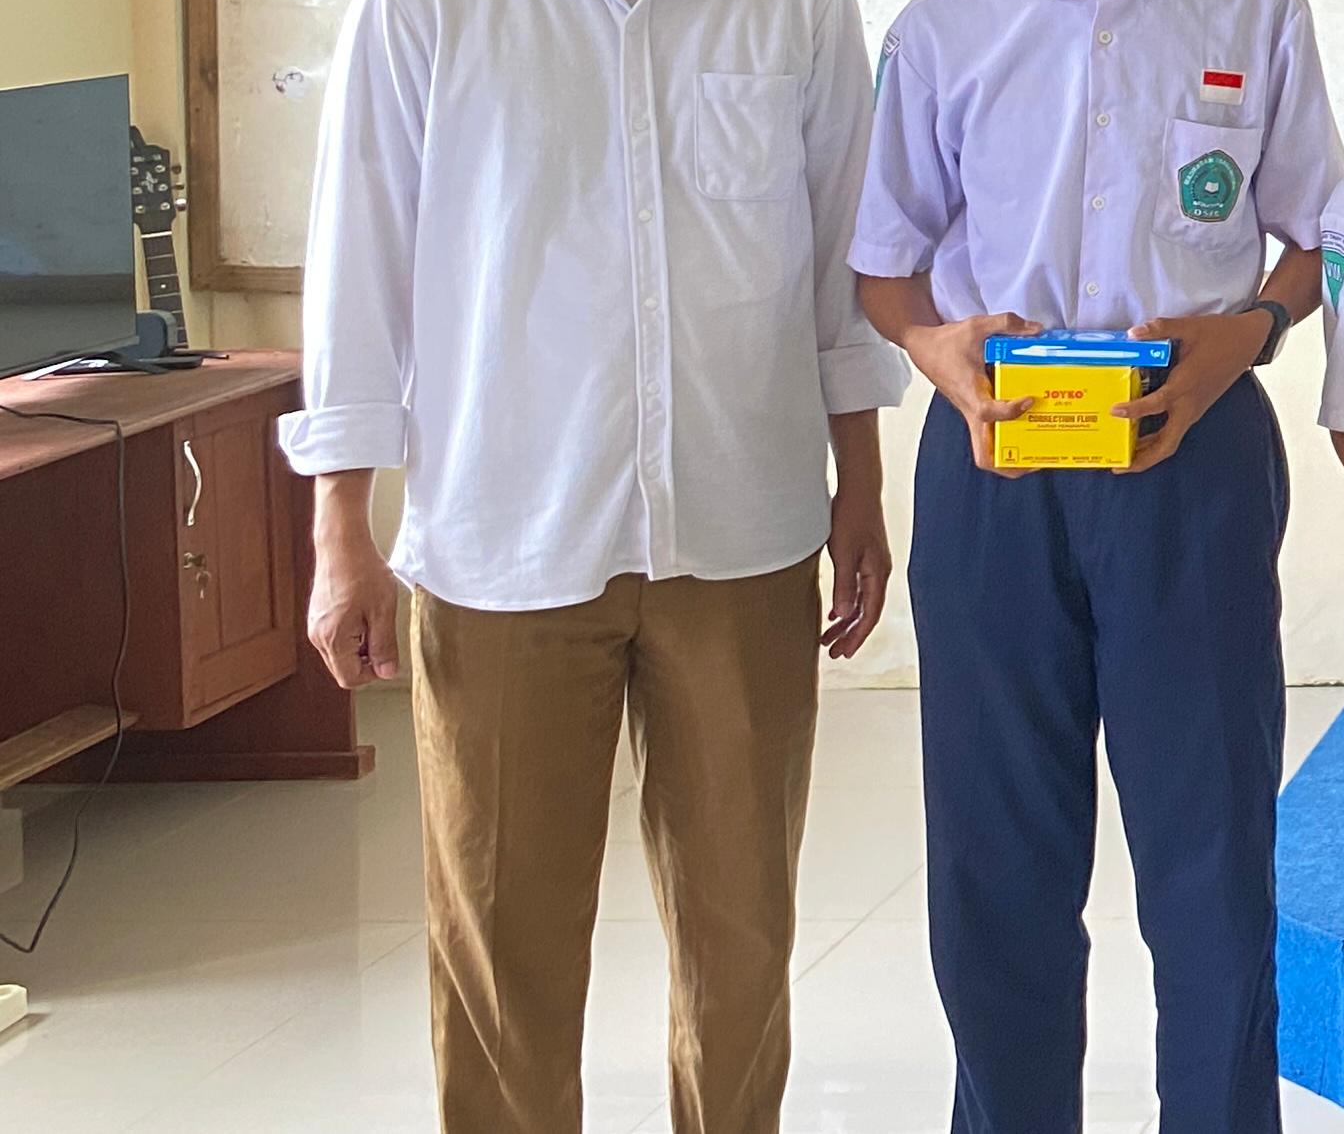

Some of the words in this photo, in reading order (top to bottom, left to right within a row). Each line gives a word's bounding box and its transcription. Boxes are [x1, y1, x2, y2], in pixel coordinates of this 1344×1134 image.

[1043, 389, 1084, 400] JOYKO
[1028, 414, 1075, 423] CORRECTION
[1076, 414, 1098, 423] FLUID
